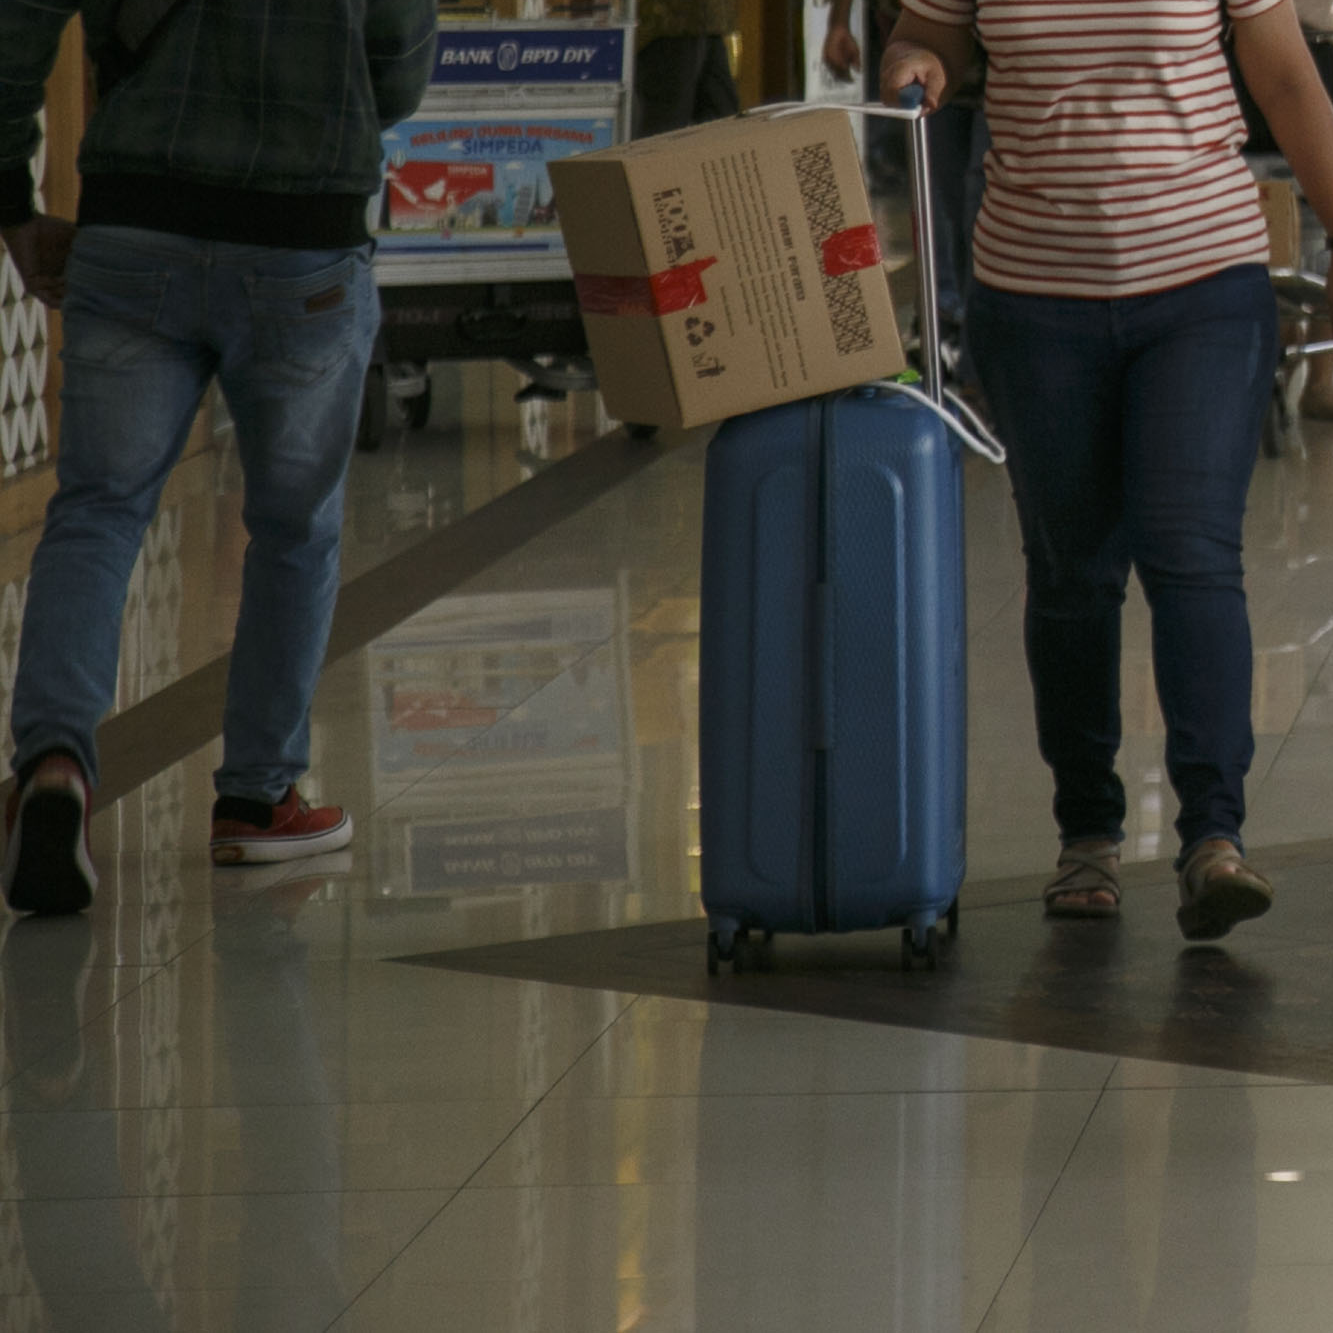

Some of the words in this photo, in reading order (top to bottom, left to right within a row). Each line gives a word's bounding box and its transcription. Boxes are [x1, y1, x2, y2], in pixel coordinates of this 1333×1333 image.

[440, 48, 495, 66] BANK
[520, 47, 560, 65] BPD
[562, 46, 597, 64] DIY
[461, 139, 545, 156] SIMPEDA
